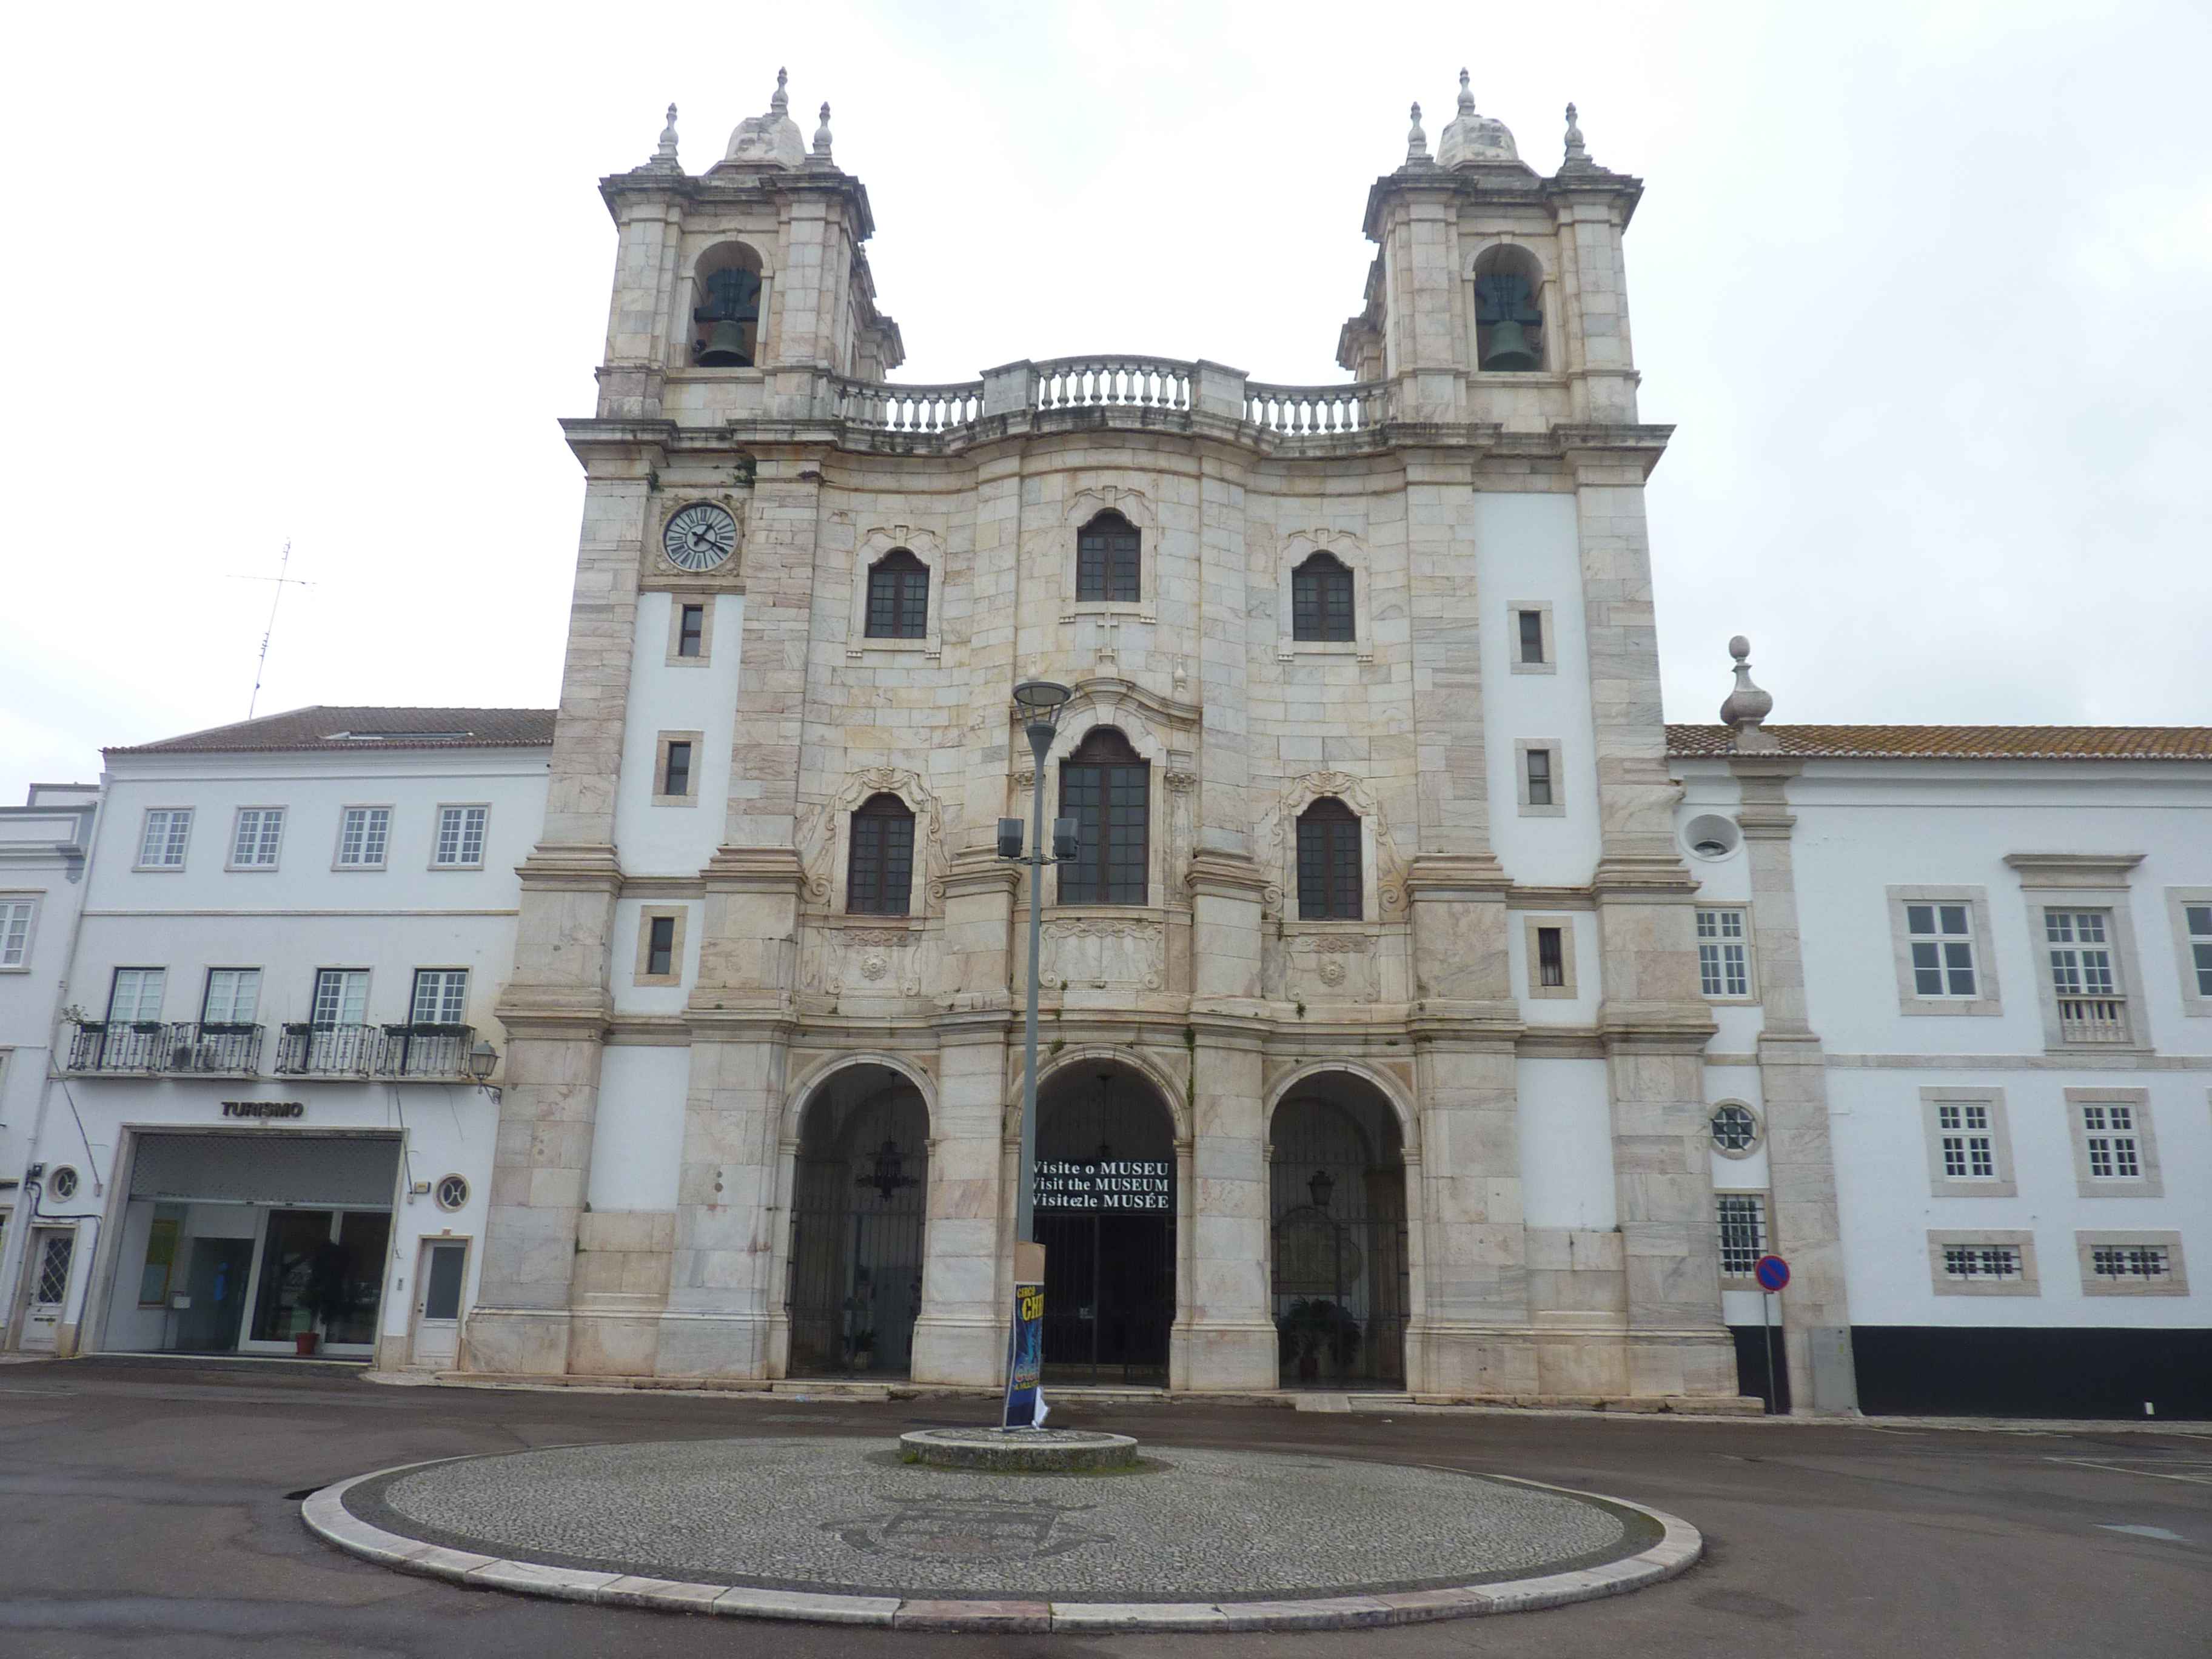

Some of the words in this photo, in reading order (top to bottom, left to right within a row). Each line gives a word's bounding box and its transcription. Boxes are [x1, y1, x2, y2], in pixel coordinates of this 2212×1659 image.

[221, 1102, 304, 1118] TURISMO
[1085, 1164, 1094, 1175] o
[1100, 1162, 1169, 1175] MUSEU
[1068, 1178, 1091, 1191] the
[1094, 1178, 1169, 1191] MUSEUM
[1103, 1192, 1169, 1208] MUSÉE
